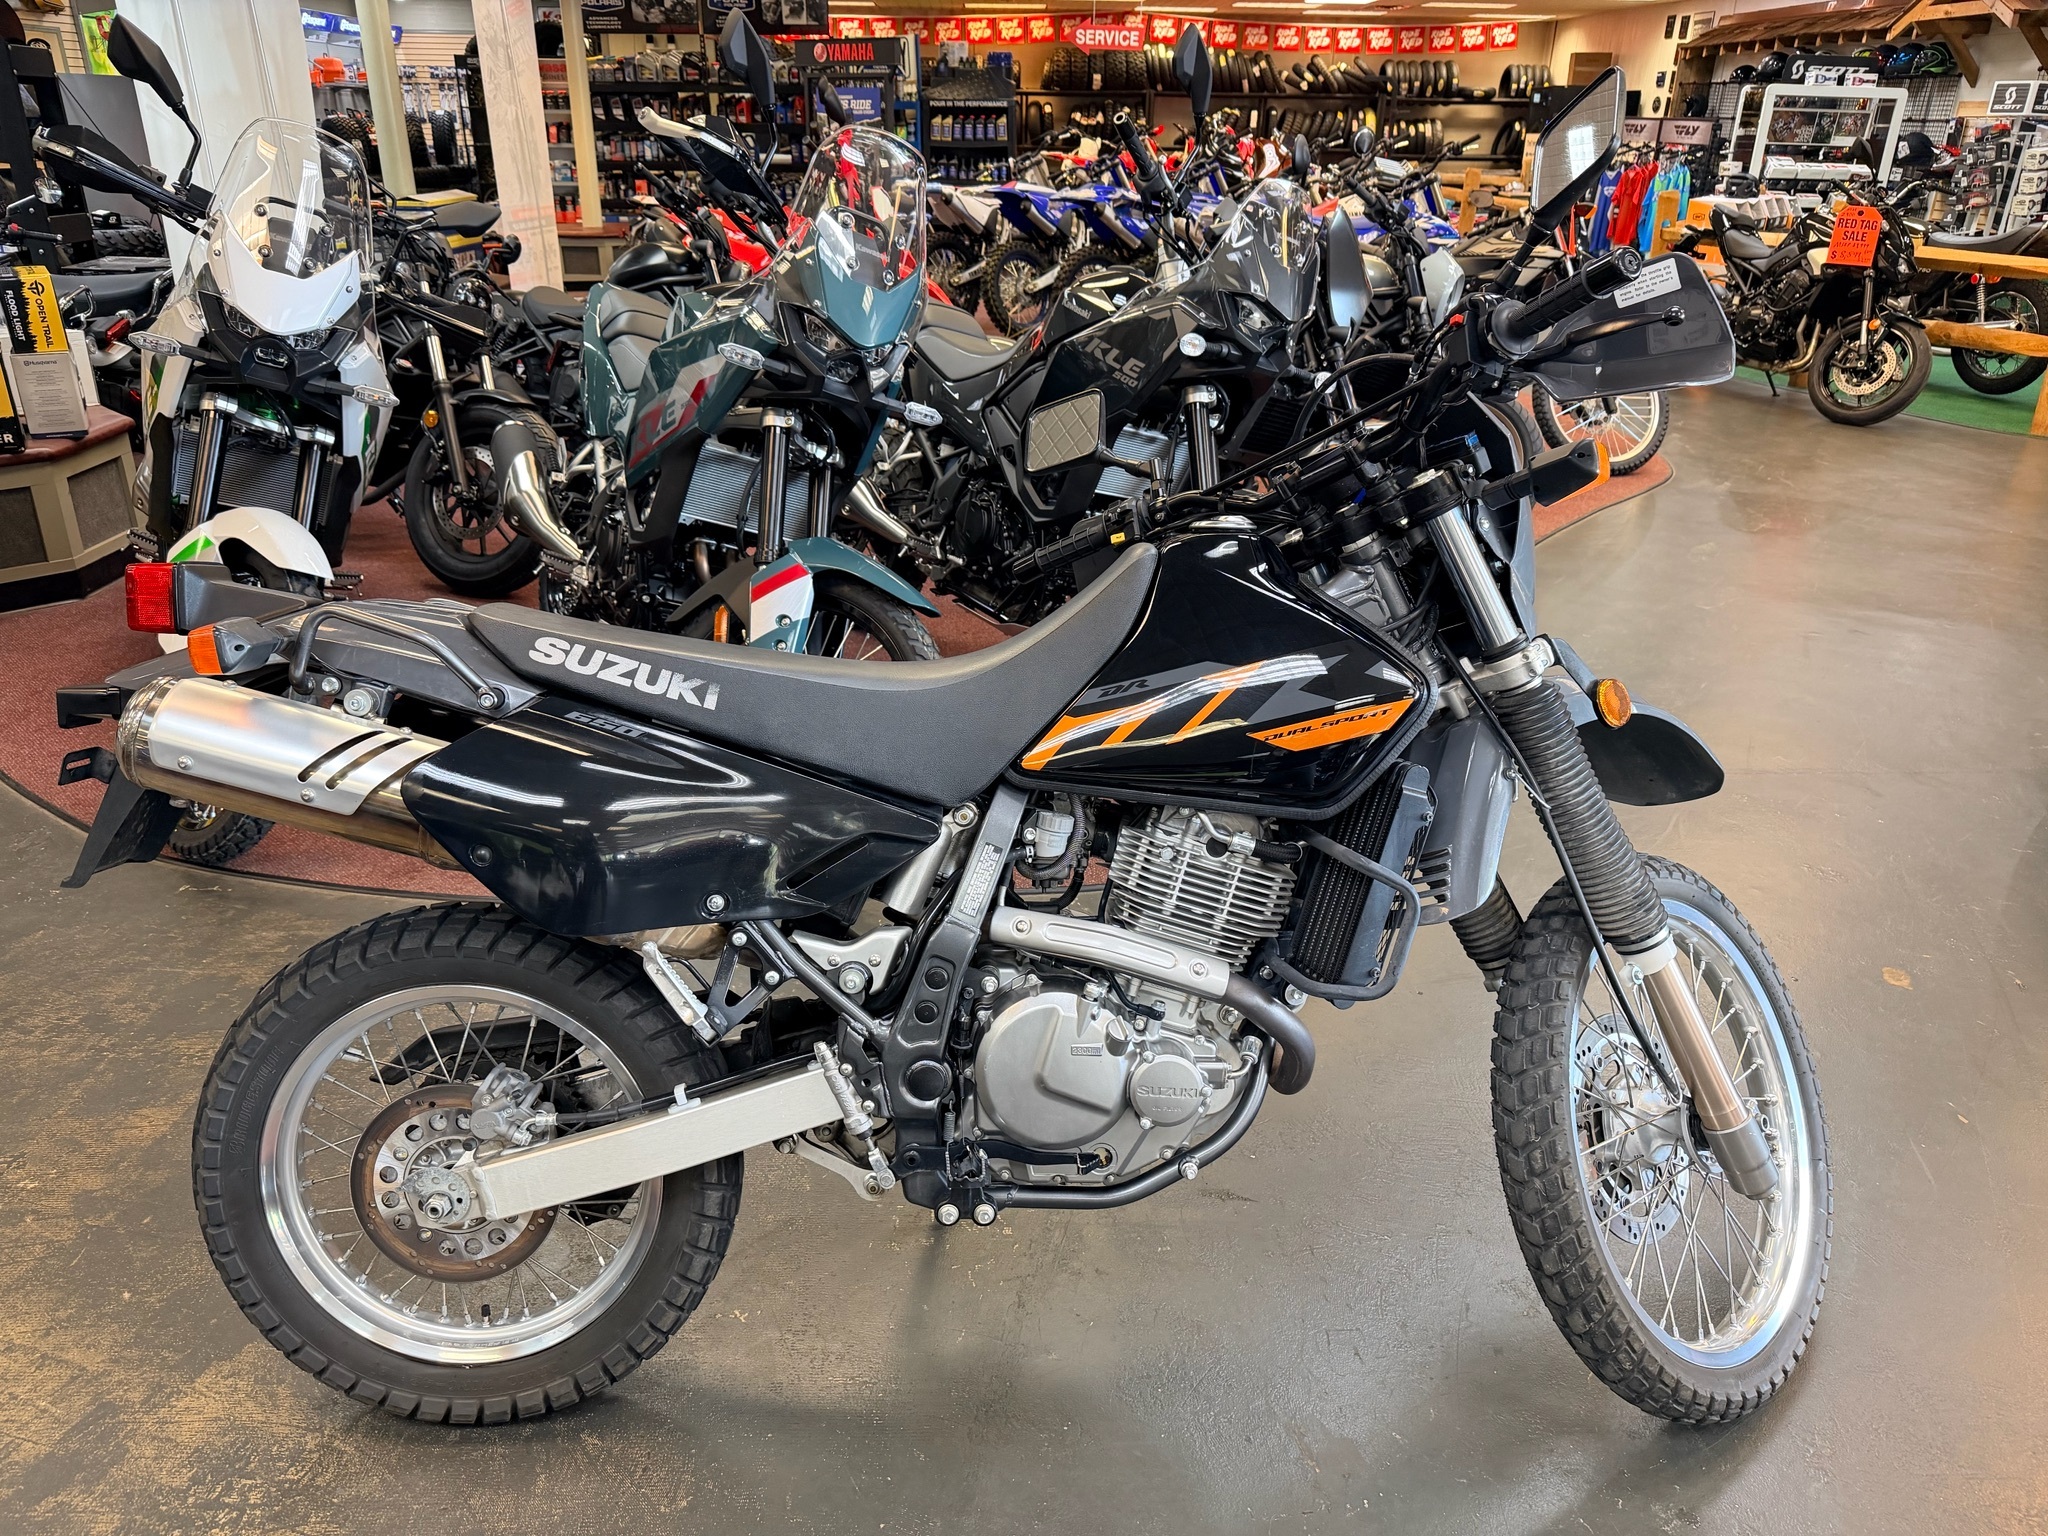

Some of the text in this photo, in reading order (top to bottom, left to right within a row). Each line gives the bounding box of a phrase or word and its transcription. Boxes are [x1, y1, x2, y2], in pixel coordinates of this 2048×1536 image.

[1075, 29, 1140, 47] SERVICE
[827, 43, 874, 61] YAMAHA
[1807, 65, 1869, 75] SCOTT
[850, 100, 872, 110] RIDE
[1837, 218, 1879, 231] RED TAG
[1842, 231, 1868, 242] SALE
[6, 290, 19, 317] FLOOD
[14, 318, 26, 342] LIGHT
[35, 298, 54, 349] OPEN TRAIL
[1085, 337, 1146, 378] KLE
[1112, 370, 1139, 388] 500
[528, 636, 721, 711] SUZUKI
[1097, 679, 1150, 699] DR
[564, 710, 647, 739] 650
[1136, 1085, 1199, 1099] SUZUKI
